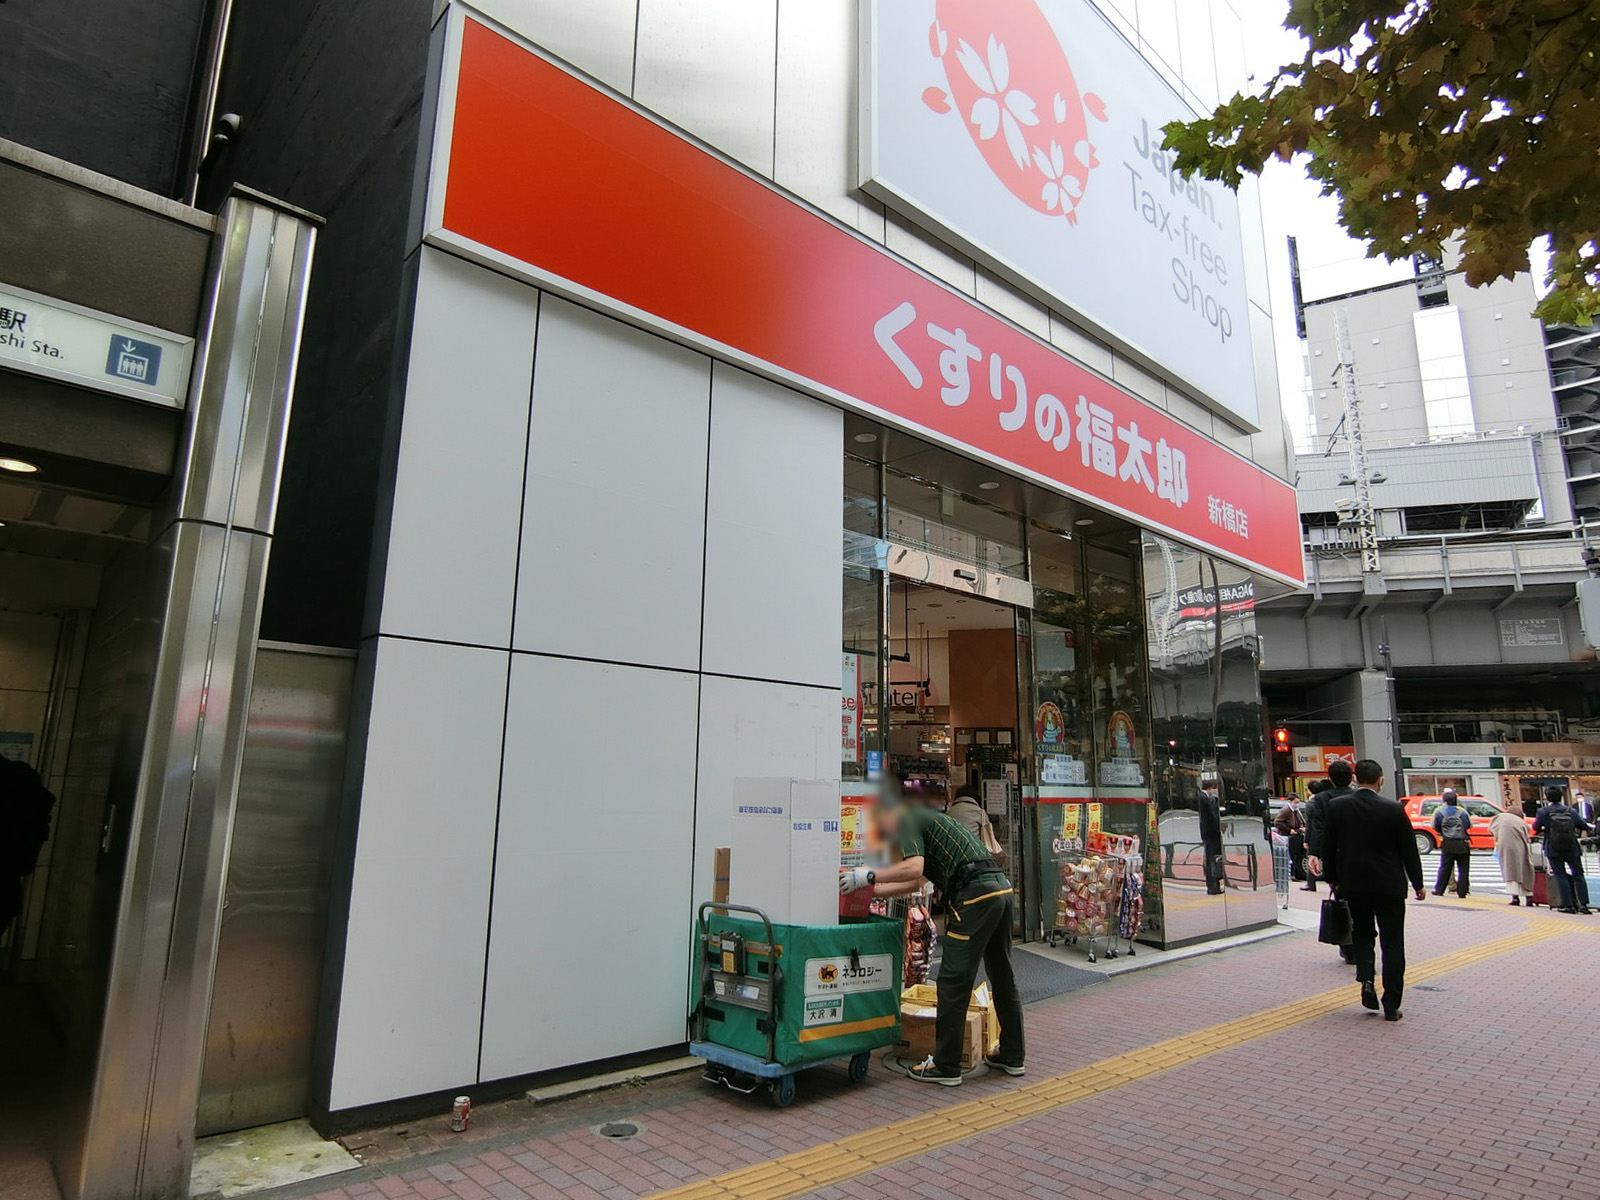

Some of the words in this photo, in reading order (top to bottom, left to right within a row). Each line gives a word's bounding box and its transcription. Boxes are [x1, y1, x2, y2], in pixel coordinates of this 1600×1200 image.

[1133, 118, 1222, 229] Japan.
[1123, 161, 1228, 287] Tax-free
[31, 340, 64, 359] Sta.
[1171, 257, 1232, 344] Shop
[873, 301, 1189, 508] くすりの福太郎
[1207, 494, 1249, 539] 新橋店
[1528, 758, 1556, 768] 生そば
